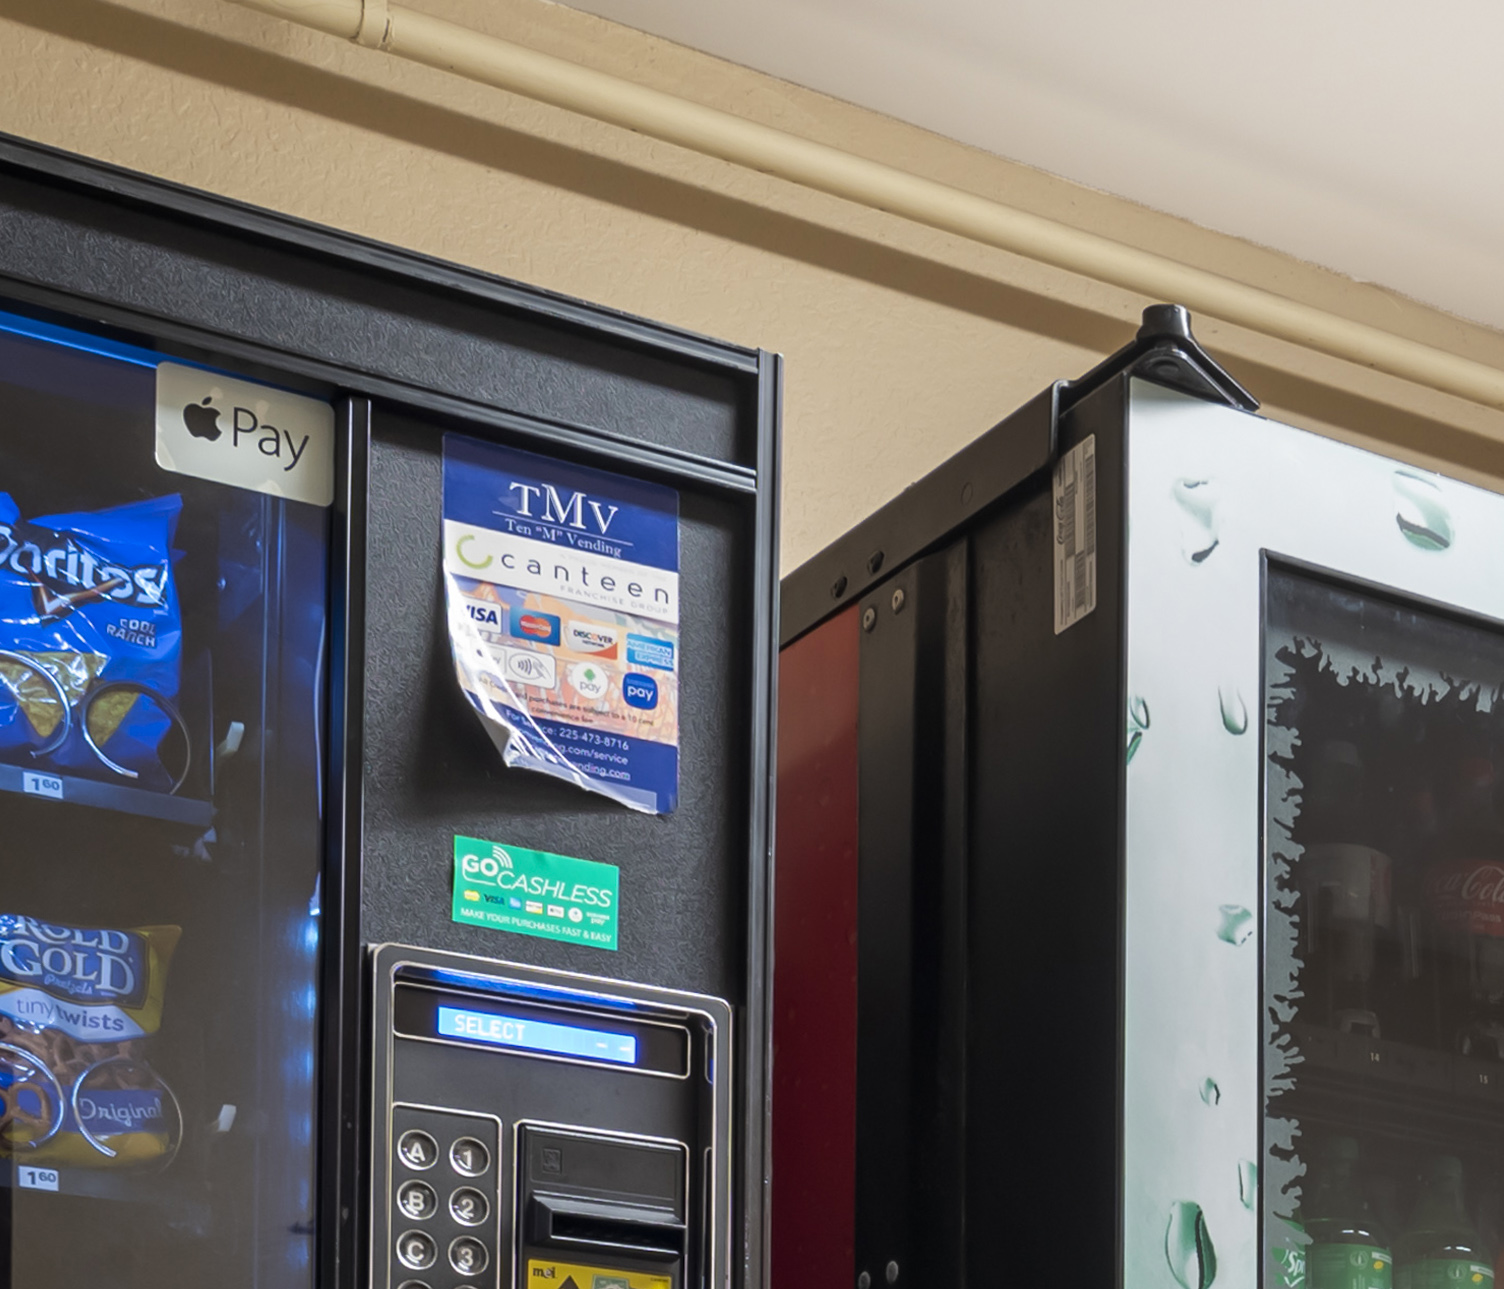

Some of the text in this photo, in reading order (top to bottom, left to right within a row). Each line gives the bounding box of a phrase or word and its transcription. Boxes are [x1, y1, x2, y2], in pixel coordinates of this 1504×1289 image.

[233, 407, 310, 472] Pay
[509, 481, 619, 535] TMV
[505, 517, 623, 559] Ten Vending
[500, 553, 670, 604] canteen
[106, 623, 157, 648] RANCH
[119, 617, 156, 634] COOL
[573, 629, 614, 645] DISCOVER
[627, 640, 672, 657] AMERICAN
[635, 651, 674, 668] EXPRESS
[579, 680, 602, 695] pay
[627, 687, 654, 702] pay
[462, 853, 613, 908] GO CASHLESS
[460, 906, 613, 943] MAKE YOUR PURCHASES EASY
[0, 935, 137, 996] GOLD
[17, 996, 126, 1033] tiny twists
[454, 1013, 526, 1042] SELECT
[1369, 1051, 1380, 1061] 14
[79, 1097, 164, 1128] Original
[460, 1248, 474, 1266] 3
